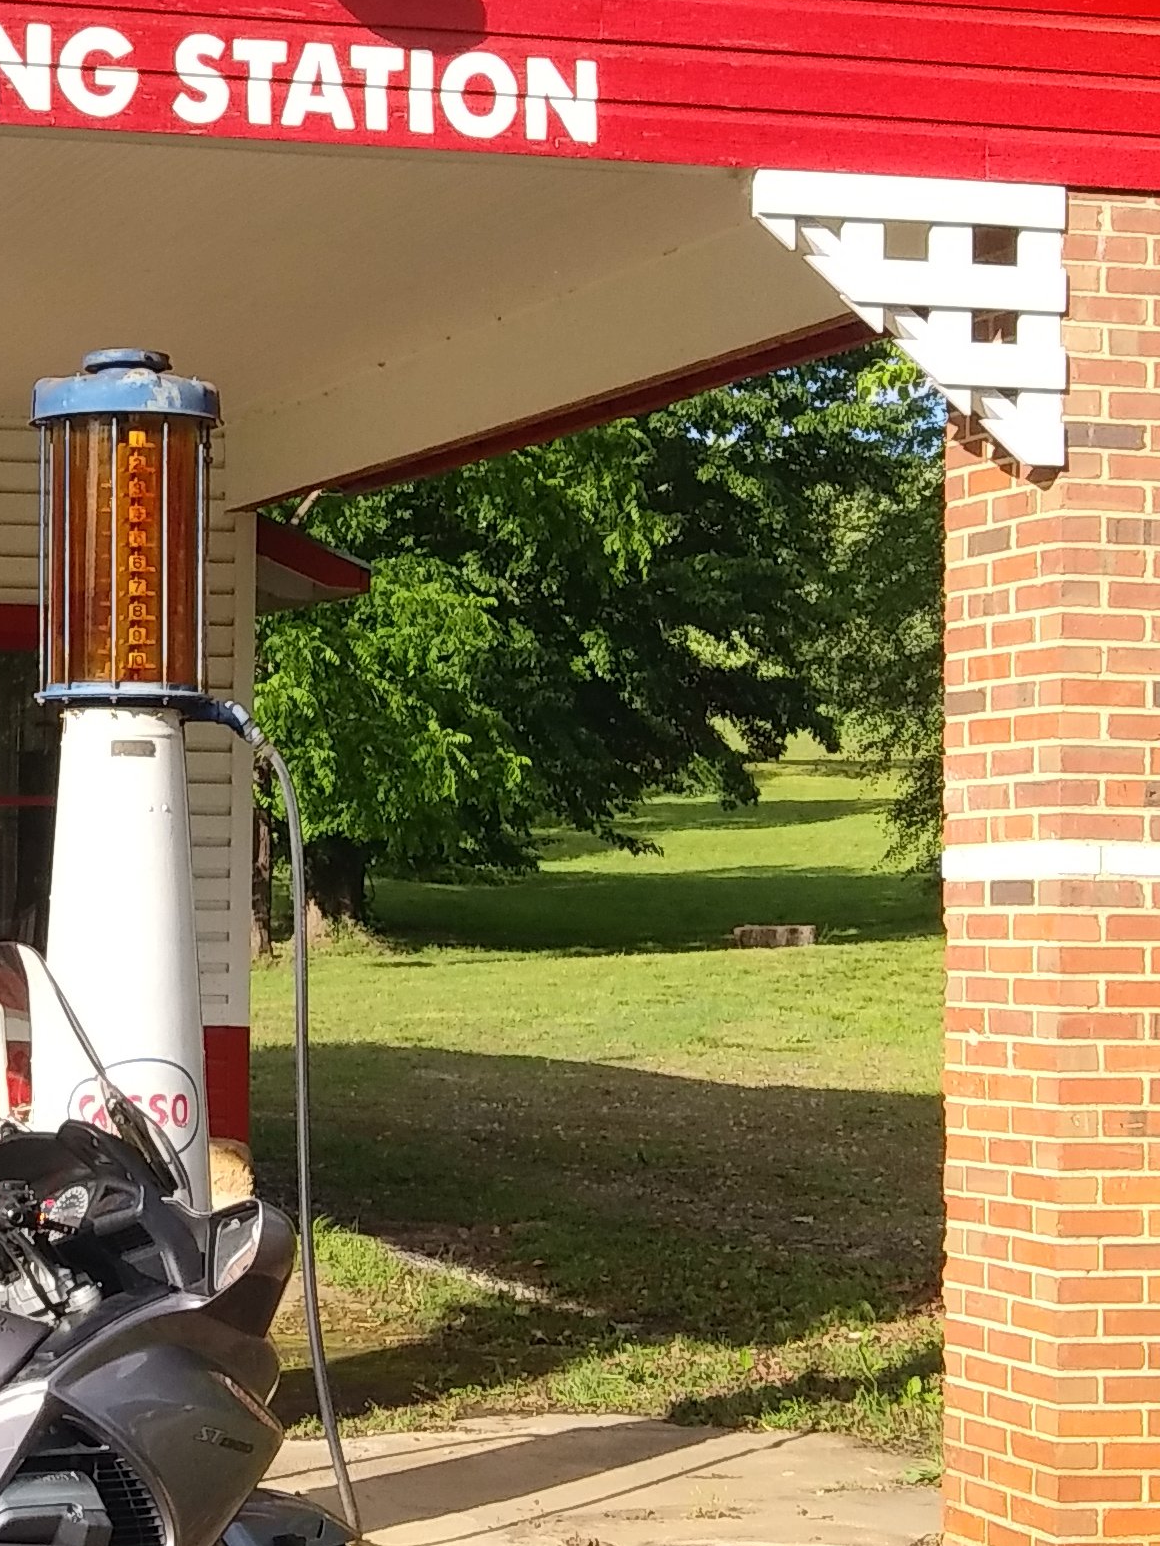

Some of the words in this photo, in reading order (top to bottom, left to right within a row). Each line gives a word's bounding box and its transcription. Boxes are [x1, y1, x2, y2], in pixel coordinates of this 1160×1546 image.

[172, 33, 599, 146] STATION
[132, 557, 142, 569] 6
[133, 580, 142, 593] 7
[132, 605, 142, 617] 8
